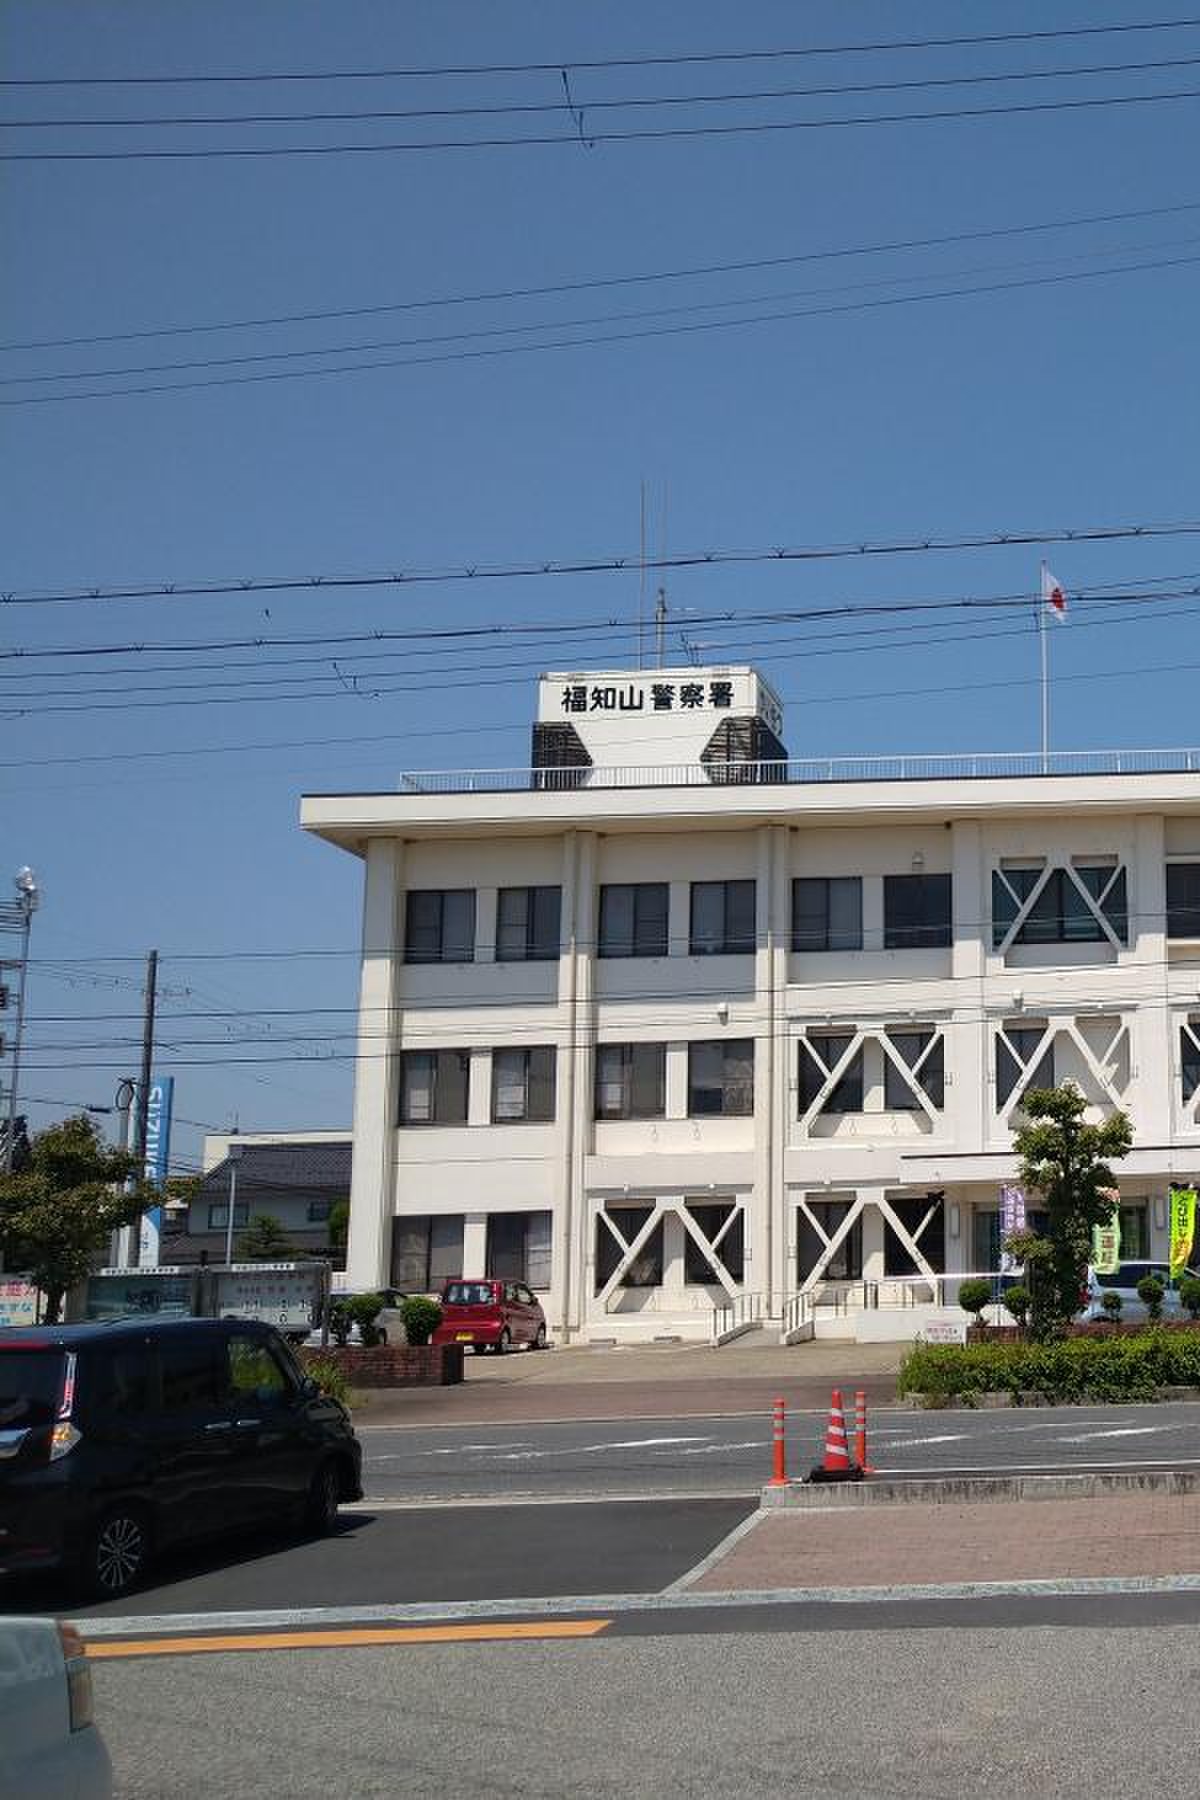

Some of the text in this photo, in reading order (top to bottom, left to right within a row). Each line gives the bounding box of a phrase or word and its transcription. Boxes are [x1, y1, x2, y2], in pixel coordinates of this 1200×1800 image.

[561, 682, 734, 713] 福知山警察署
